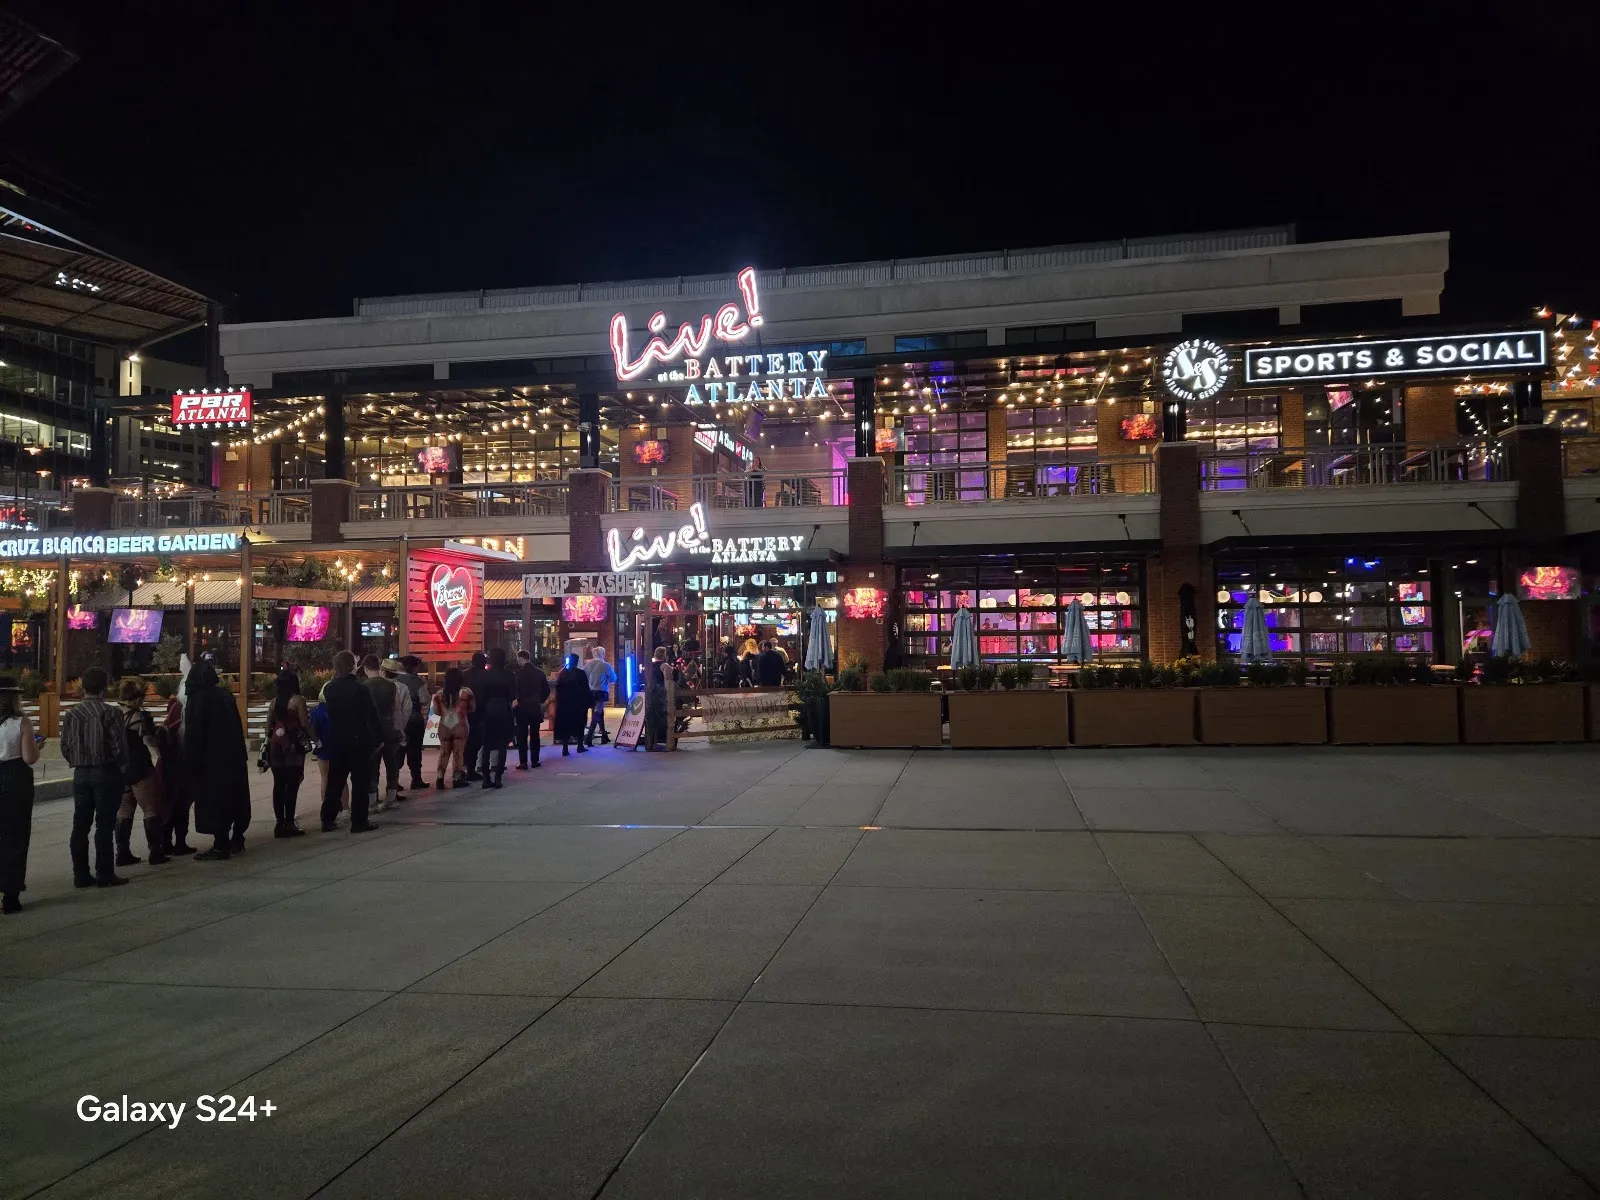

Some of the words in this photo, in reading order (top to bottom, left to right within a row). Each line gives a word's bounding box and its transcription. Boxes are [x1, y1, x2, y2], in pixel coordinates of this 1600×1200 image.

[610, 266, 763, 381] Live!
[684, 350, 828, 380] BATTERY
[1256, 349, 1373, 375] SPORTS
[1385, 347, 1404, 367] &
[1416, 340, 1534, 364] SOCIAL
[180, 395, 243, 409] PBR
[683, 377, 828, 405] ATLANTA
[176, 407, 248, 421] ATLANTA
[0, 538, 40, 557] CRUZ
[42, 536, 104, 555] BLANCA
[106, 535, 155, 554] BEER
[158, 533, 237, 551] GARDEN
[607, 502, 710, 572] Live!
[711, 536, 805, 553] BATTERY
[711, 549, 778, 563] ATLANTA
